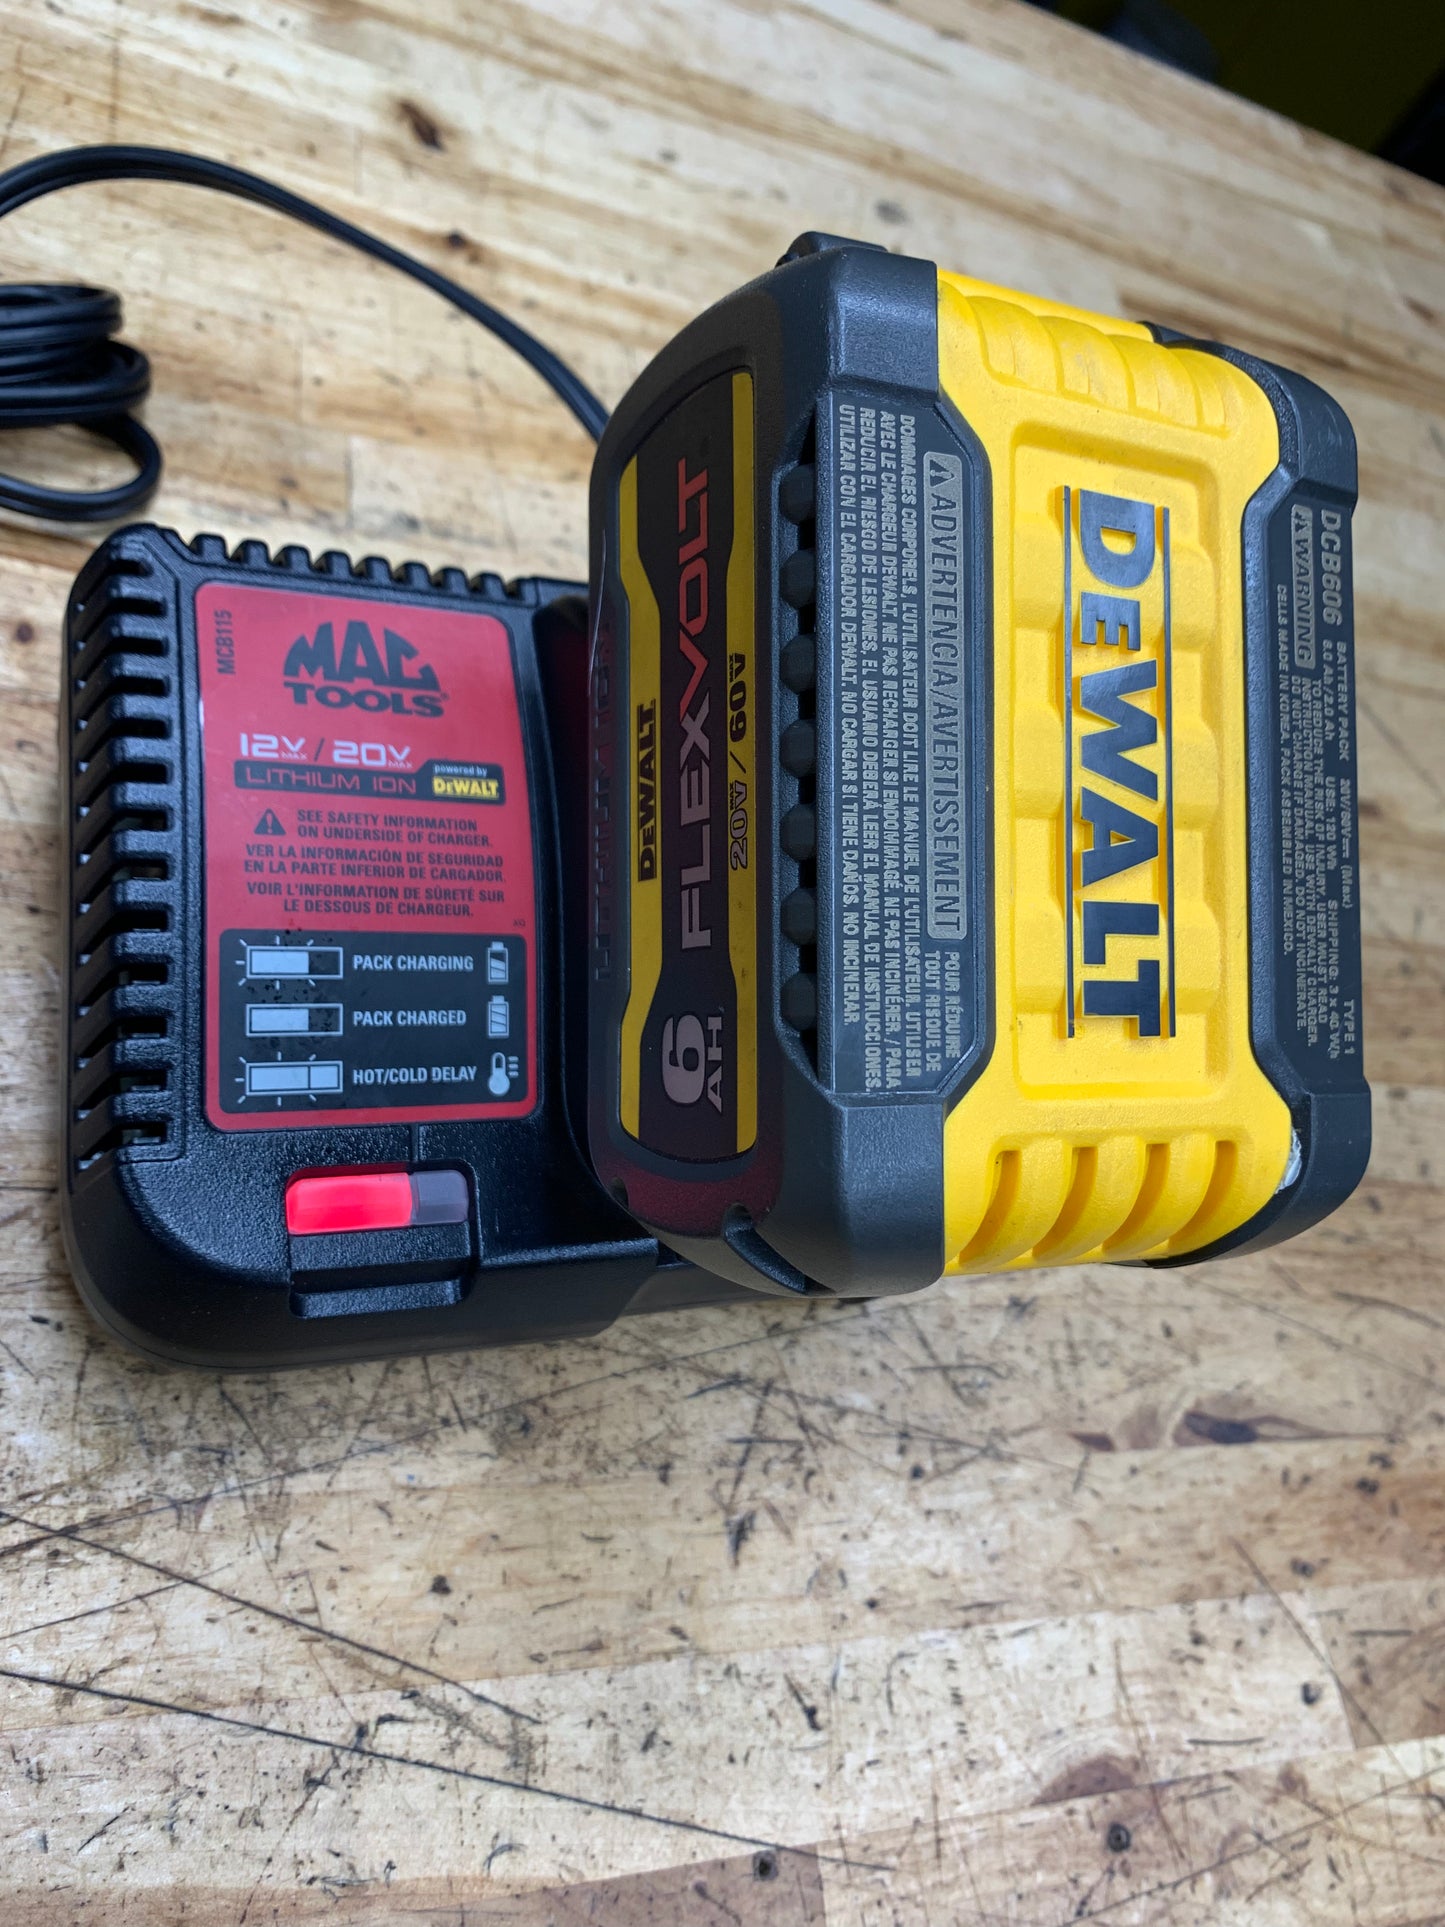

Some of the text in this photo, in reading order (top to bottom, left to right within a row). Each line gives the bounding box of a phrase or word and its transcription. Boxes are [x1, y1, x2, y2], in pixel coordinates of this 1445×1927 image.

[839, 404, 855, 471] UTILIZAR
[880, 411, 896, 449] AVEC
[881, 452, 897, 469] LE
[900, 415, 916, 504] DOMMAGES
[840, 475, 856, 507] CON
[840, 512, 856, 528] EL
[881, 472, 897, 552] CHARGEUR
[901, 508, 918, 598] CORPORELS,
[1321, 510, 1342, 626] DCB606
[840, 532, 857, 618] CARGADOR
[1295, 537, 1312, 661] WARNING
[213, 608, 236, 675] MCB115
[882, 622, 898, 642] NE
[283, 620, 442, 692] MAC
[882, 647, 898, 676] PAS
[901, 602, 919, 708] L'UTILISATEUR
[1312, 679, 1322, 697] TO
[1336, 641, 1348, 714] BATTERY
[283, 681, 445, 719] TOOLS
[842, 691, 858, 713] NO
[882, 680, 899, 767] RECHARGER
[903, 712, 919, 749] DOIT
[1302, 677, 1313, 771] INSTRUCTION
[1313, 700, 1324, 754] REDUCE
[1338, 717, 1350, 762] PACK
[842, 717, 858, 780] CARGAR
[860, 407, 882, 1092] REDUCIR EL RIESGO DE LESIONES, EL USUARIO DEBERÁ LEER EL MANUAL DE INSTRUCCIONES.
[903, 751, 919, 782] LIRE
[1079, 488, 1161, 1037] DEWALT
[246, 767, 417, 795] LITHIUM ION
[433, 763, 488, 777] powered by
[638, 700, 656, 879] DEWALT
[883, 771, 899, 786] SI
[1277, 584, 1294, 956] CELLS MADE IN KOREA. PACK ASSEMBLED IN MEXICO.
[1314, 759, 1324, 784] THE
[842, 784, 858, 799] SI
[903, 786, 919, 802] LE
[1314, 788, 1325, 820] RISK
[297, 809, 478, 832] SEE SAFETY INFORMATION
[298, 825, 319, 838] ON
[323, 826, 404, 844] UNDERSIDE
[407, 831, 423, 844] OF
[842, 803, 859, 847] TIENE
[883, 789, 903, 892] ENDOMMAGÉ.
[903, 806, 920, 870] MANUEL
[1315, 824, 1325, 841] OF
[1325, 775, 1337, 870] USE: 120 Wh
[244, 859, 264, 873] EN
[269, 861, 287, 874] LA
[291, 862, 337, 876] PARTE
[341, 863, 405, 879] INFERIOR
[409, 865, 426, 880] DE
[246, 843, 504, 868] VER LA INFORMACIÓN DE SEGURIDAD
[1291, 675, 1307, 1030] DO NOT CHARGE IF DAMAGED. DO NOT INCINERATE.
[1305, 844, 1315, 870] USE
[247, 882, 283, 896] VOIR
[287, 883, 399, 899] L'INFORMATION
[403, 886, 421, 900] DE
[478, 889, 505, 902] SUR
[843, 850, 863, 908] DAÑOS.
[904, 875, 920, 893] DE
[1305, 874, 1315, 911] WITH
[284, 899, 474, 917] LE DESSOUS DE CHARGEUR.
[843, 912, 860, 935] NO
[884, 897, 900, 917] NE
[1317, 903, 1327, 938] USER
[884, 920, 900, 949] PAS
[1306, 915, 1317, 974] DEWALT
[1328, 900, 1339, 980] SHIPPING:
[353, 954, 475, 972] PACK CHARGING
[843, 939, 860, 1026] INCINERAR.
[1317, 941, 1328, 983] MUST
[884, 953, 903, 1035] INCINÉRER.
[945, 952, 964, 1058] POUR RÉDUIRE
[1318, 987, 1328, 1023] READ
[1329, 985, 1339, 994] 3
[353, 1009, 467, 1026] PACK CHARGED
[925, 950, 942, 1072] TOUT RISQUE DE
[1307, 977, 1318, 1046] CHARGER.
[1344, 999, 1355, 1055] TYPE 1
[661, 1014, 706, 1104] 6
[706, 1016, 722, 1113] AH
[905, 1011, 922, 1077] UTILISER
[353, 1065, 478, 1085] HOT/COLD DELAY
[885, 1048, 902, 1089] PARA
